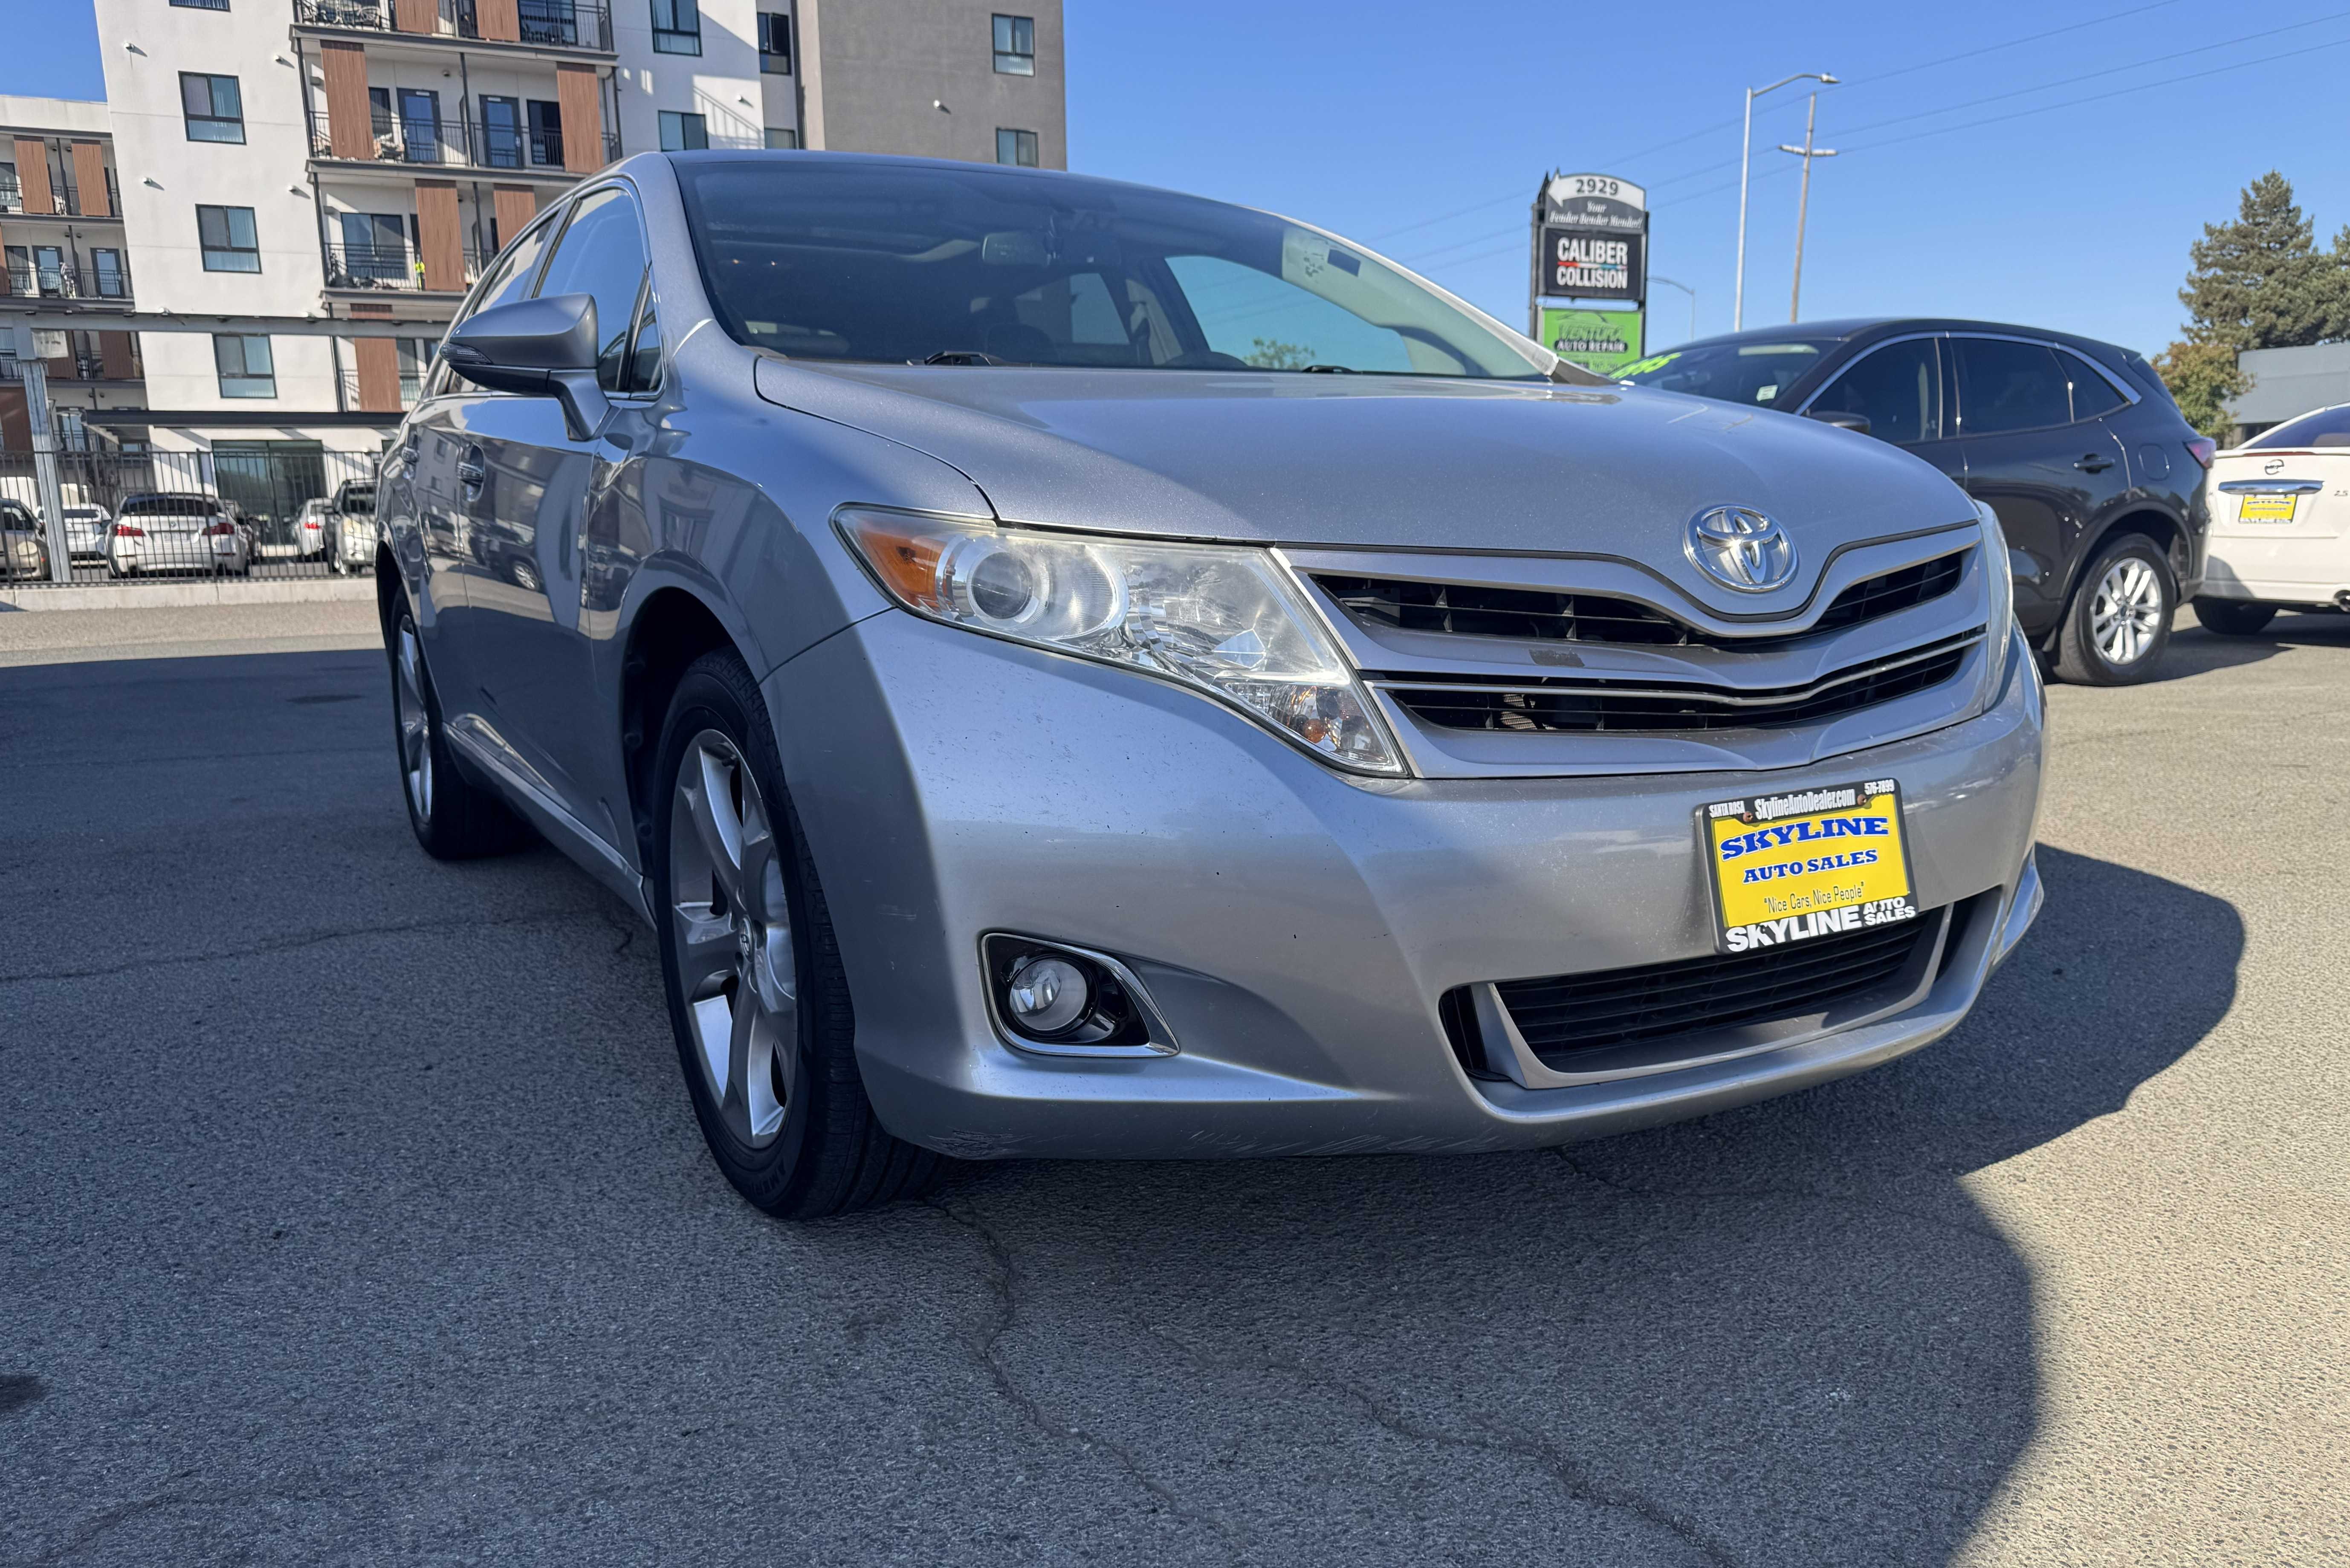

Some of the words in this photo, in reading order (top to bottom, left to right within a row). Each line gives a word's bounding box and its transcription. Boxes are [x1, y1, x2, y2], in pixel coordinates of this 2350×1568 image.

[1576, 179, 1618, 196] 2929
[1587, 200, 1607, 213] Your
[1557, 237, 1628, 265] CALIBER
[1557, 266, 1628, 289] COLLISION
[1557, 340, 1587, 351] AUTO
[1589, 341, 1625, 353] REPAIR
[1709, 803, 1728, 818] SANTA
[1728, 800, 1745, 815] ROSA
[1754, 789, 1856, 820] SkylineAutoDealer.com
[1720, 817, 1889, 861] SKYLINE
[1743, 861, 1803, 884] AUTO
[1807, 849, 1878, 873] SALES
[1764, 897, 1787, 914] "Nice
[1790, 893, 1812, 909] Cars,
[1813, 889, 1832, 905] Nice
[1833, 881, 1864, 903] People"
[1863, 897, 1905, 914] AUTO
[1864, 906, 1916, 925] SALES
[1725, 905, 1862, 952] SKYLINE
